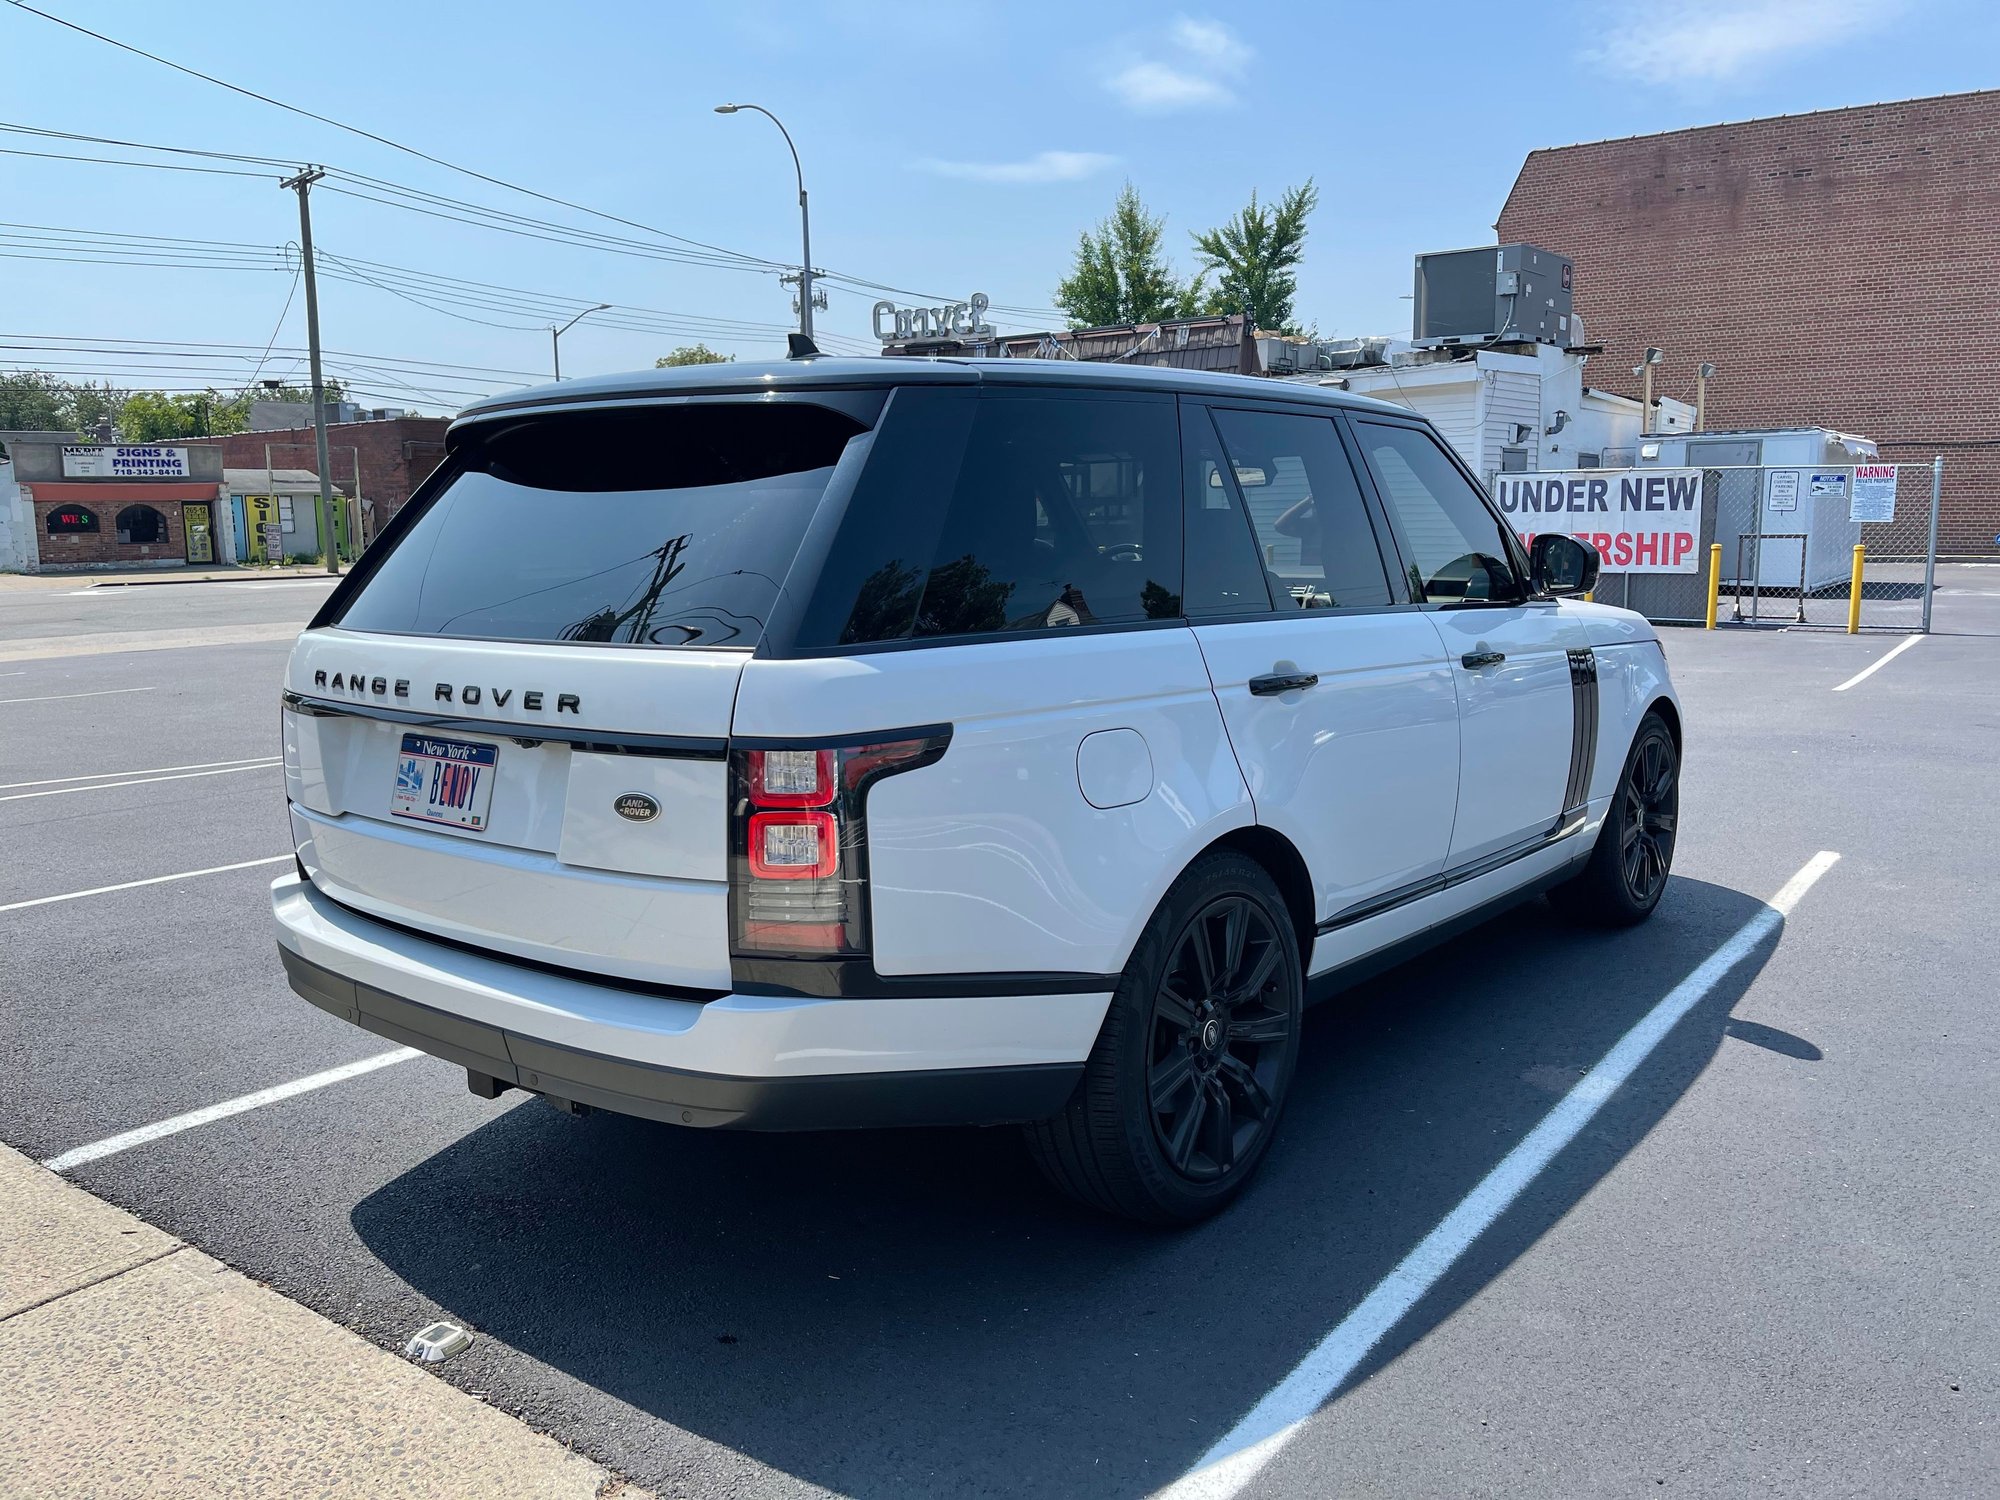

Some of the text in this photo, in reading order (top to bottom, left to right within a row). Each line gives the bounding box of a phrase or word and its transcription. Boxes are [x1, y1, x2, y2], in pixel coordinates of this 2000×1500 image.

[873, 292, 990, 340] Carvel
[117, 448, 176, 457] SIGNS &
[112, 458, 182, 468] PRINTING
[1855, 466, 1895, 478] WARNING
[1500, 477, 1698, 513] UNDER NEW
[1518, 532, 1693, 566] RSHIP
[314, 669, 581, 714] RANGE ROVER
[422, 740, 470, 760] New York
[429, 761, 481, 811] BENOY
[621, 798, 644, 808] LAND
[623, 807, 651, 817] ROVER
